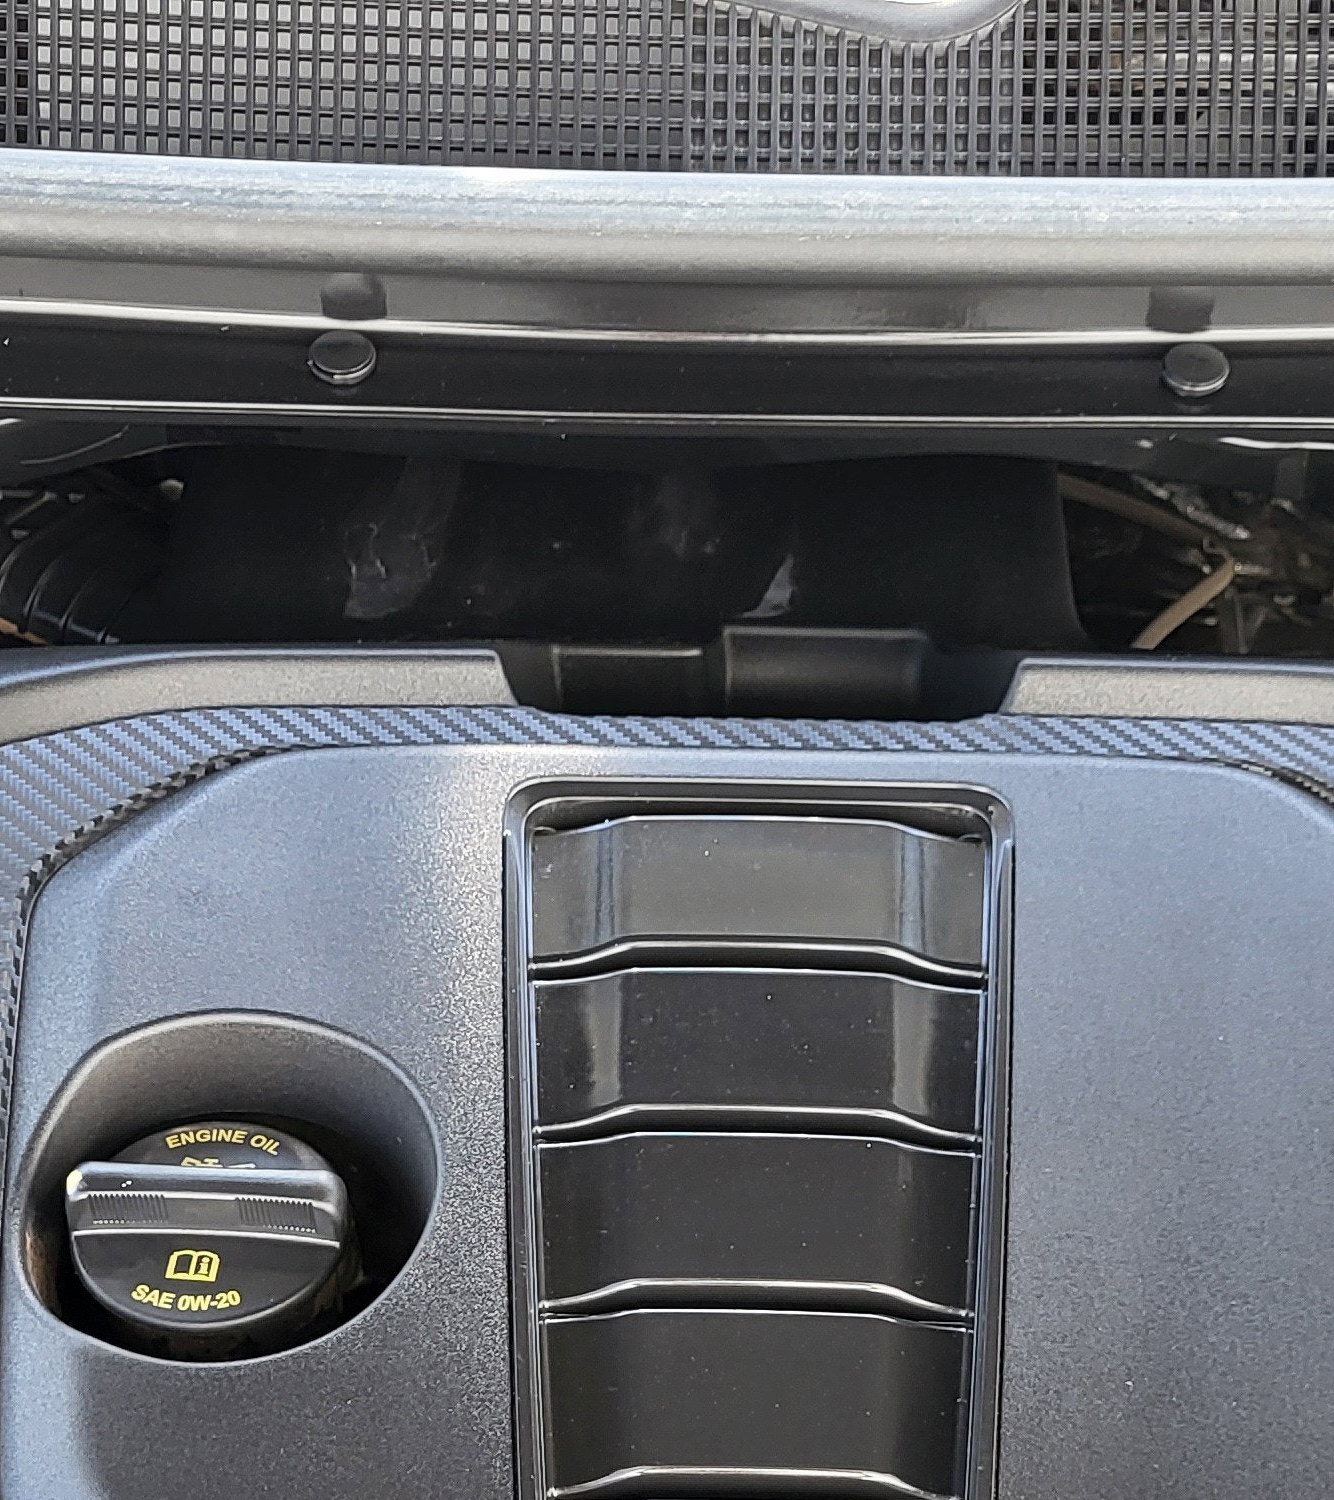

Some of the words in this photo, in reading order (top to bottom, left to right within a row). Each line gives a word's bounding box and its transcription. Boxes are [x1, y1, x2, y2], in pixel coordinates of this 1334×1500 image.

[165, 1128, 248, 1150] ENGINE
[250, 1134, 281, 1156] OIL
[131, 1284, 174, 1310] SAE
[177, 1289, 242, 1312] 0W-20
